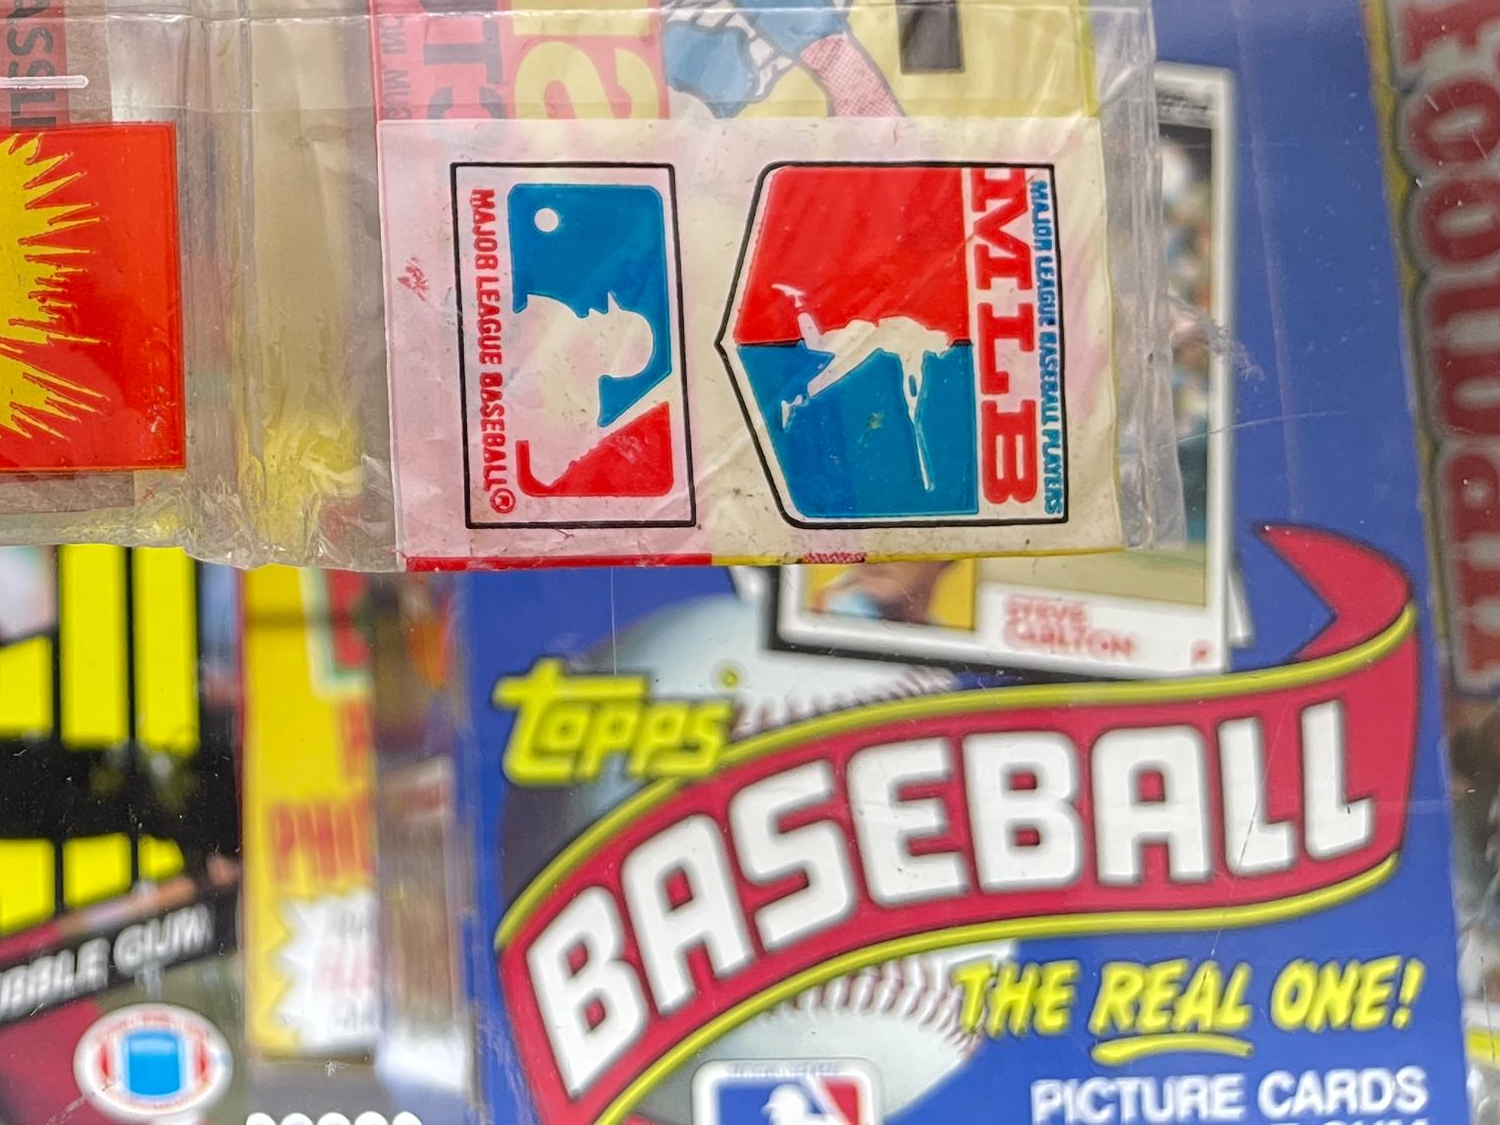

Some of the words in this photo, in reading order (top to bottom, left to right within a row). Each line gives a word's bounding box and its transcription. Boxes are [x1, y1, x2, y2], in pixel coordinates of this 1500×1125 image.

[470, 188, 498, 270] MAJOR
[1030, 181, 1053, 251] MAJOR
[476, 277, 502, 364] LEAGUE
[1036, 257, 1056, 327] LEAGUE
[971, 168, 1037, 504] MLB
[1039, 332, 1060, 425] BASEBALL
[1041, 429, 1063, 515] PLAYERS
[113, 903, 215, 973] GUM
[526, 700, 1375, 1101] BASEBALL
[953, 958, 1079, 1035] THE
[1090, 957, 1254, 1031] REAL
[1270, 956, 1426, 1030] ONE!
[1030, 1073, 1246, 1125] PICTURE
[1257, 1065, 1430, 1115] CARDS
